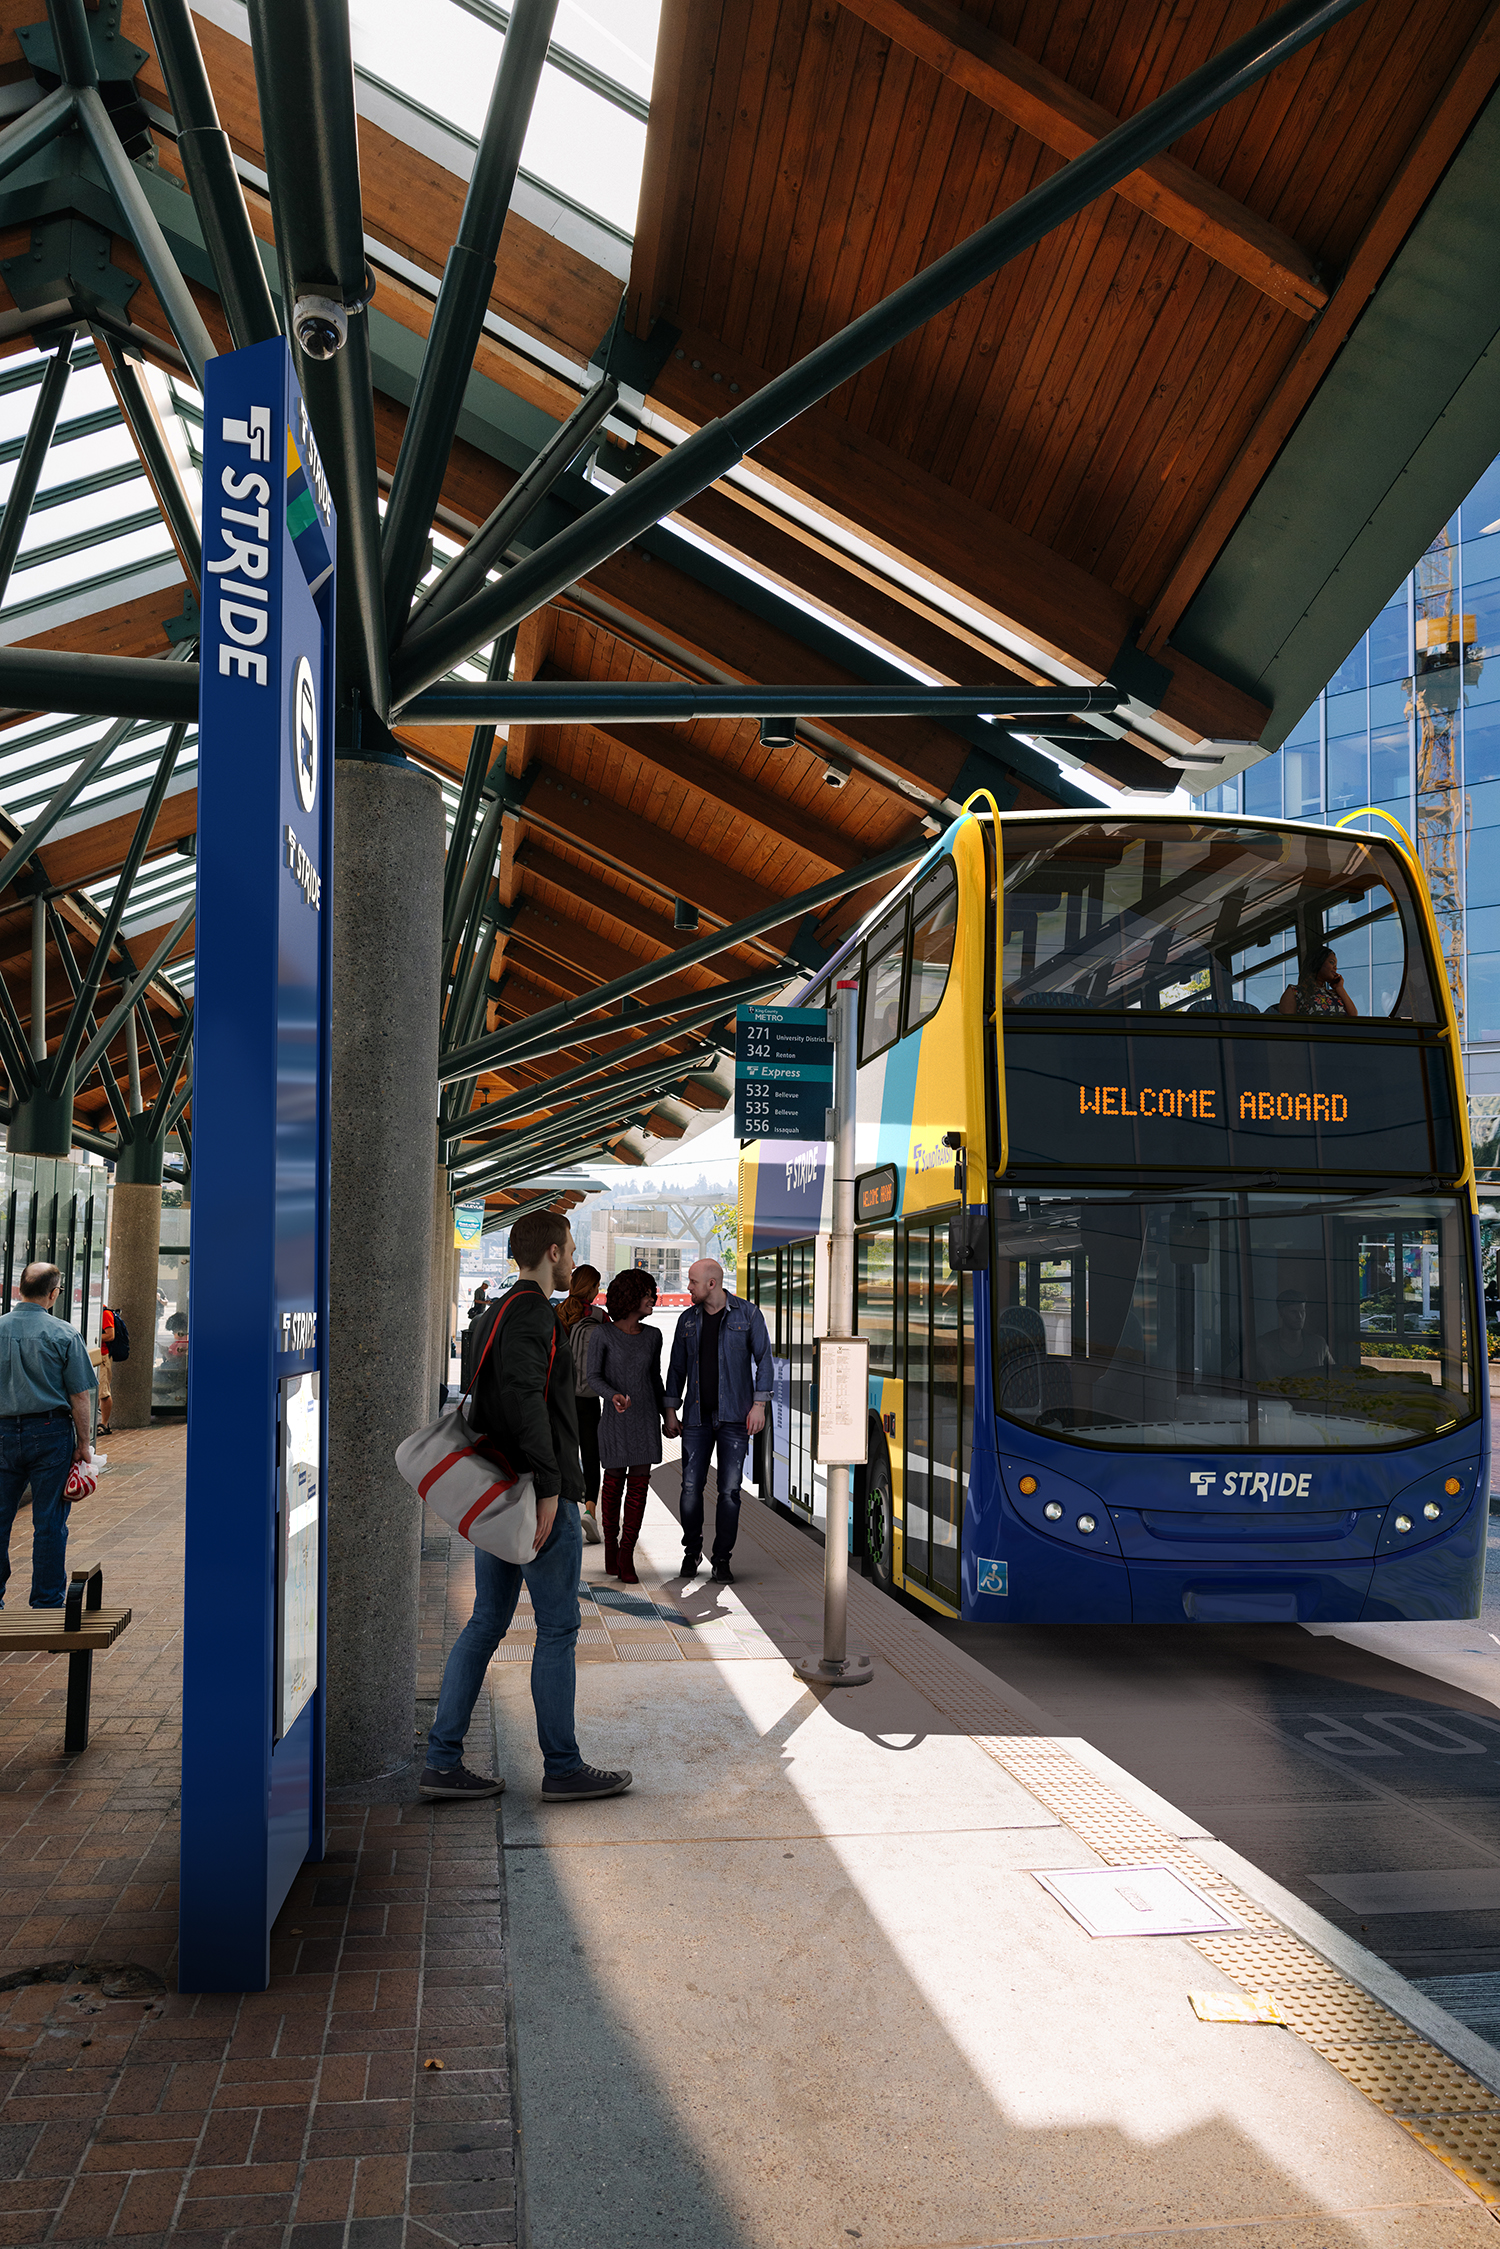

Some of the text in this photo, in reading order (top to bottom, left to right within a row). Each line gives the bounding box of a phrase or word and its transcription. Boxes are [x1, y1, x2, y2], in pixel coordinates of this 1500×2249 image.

[306, 430, 332, 527] STRIDE
[207, 465, 271, 687] STRIDE
[295, 843, 321, 911] STRIDE
[754, 1013, 784, 1022] METRO
[747, 1026, 826, 1043] 271 University District
[746, 1043, 796, 1059] 342 Renton
[761, 1066, 801, 1079] Express
[746, 1083, 799, 1099] 532 Bellevue
[745, 1101, 799, 1116] 535 Bellevue
[1079, 1085, 1348, 1122] WELCOME ABOARD
[745, 1119, 800, 1135] 556 Issaquah
[793, 1145, 819, 1194] STRIDE
[291, 1312, 317, 1360] STRIDE
[1222, 1471, 1313, 1502] STRIDE
